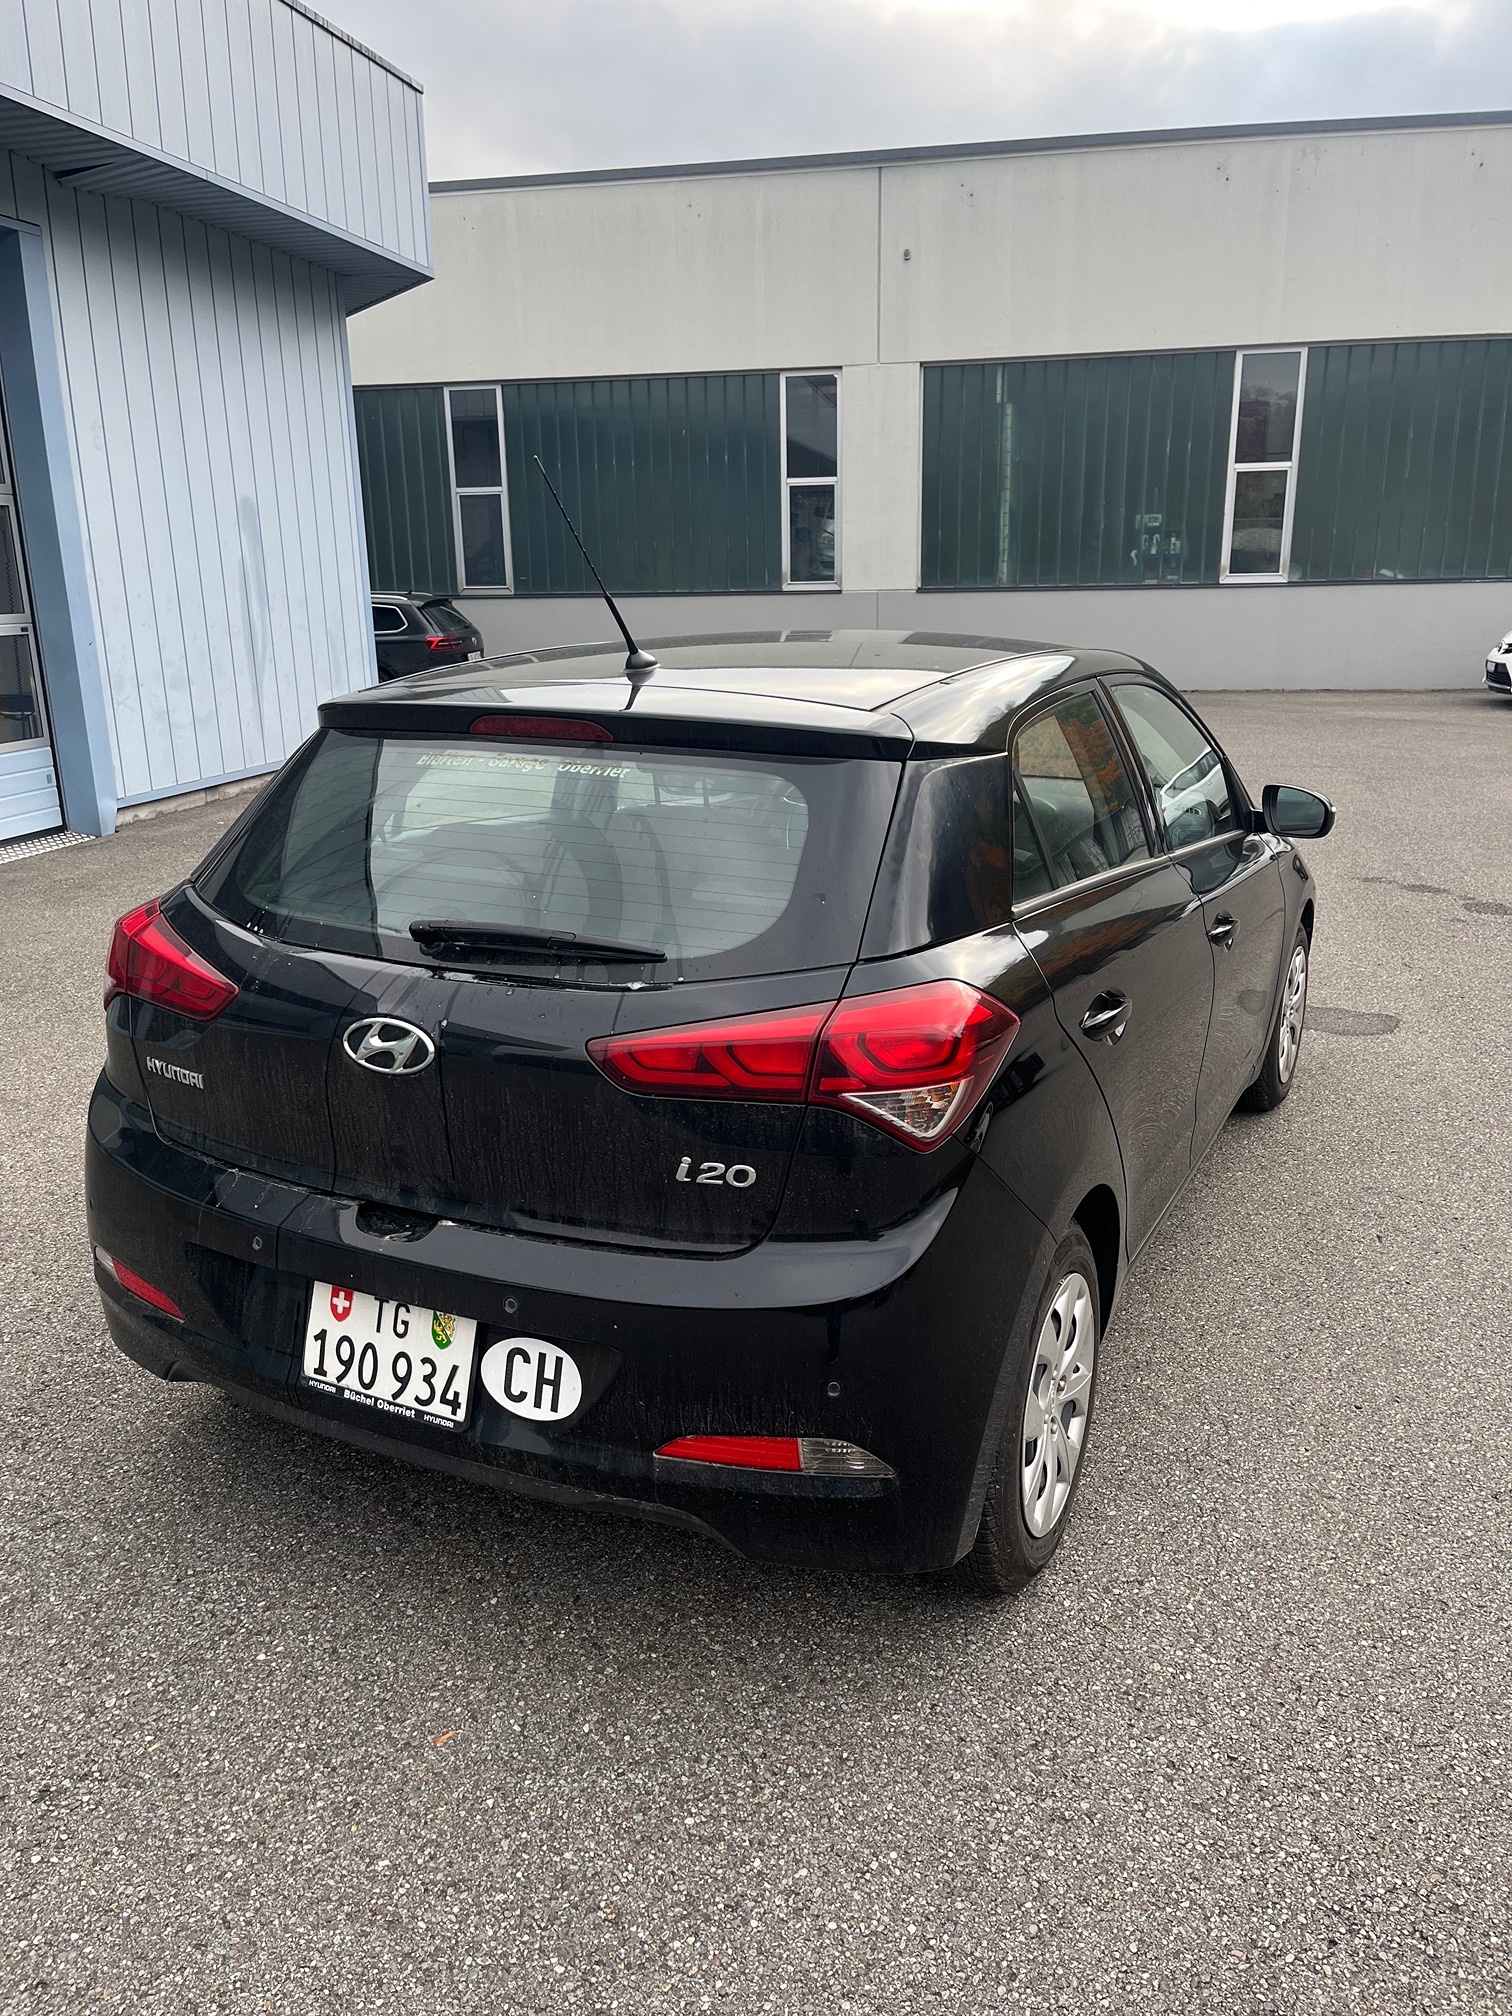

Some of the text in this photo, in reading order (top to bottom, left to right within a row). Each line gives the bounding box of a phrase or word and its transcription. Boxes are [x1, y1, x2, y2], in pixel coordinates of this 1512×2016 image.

[557, 759, 631, 778] Oberriet
[146, 1056, 205, 1090] HYUNDAI
[675, 1156, 757, 1188] i20
[374, 1296, 411, 1339] TG
[313, 1328, 461, 1416] 190 934
[503, 1346, 563, 1413] CH
[308, 1379, 454, 1429] HYUNDAI Büchel Oberriet HYUNDAI
